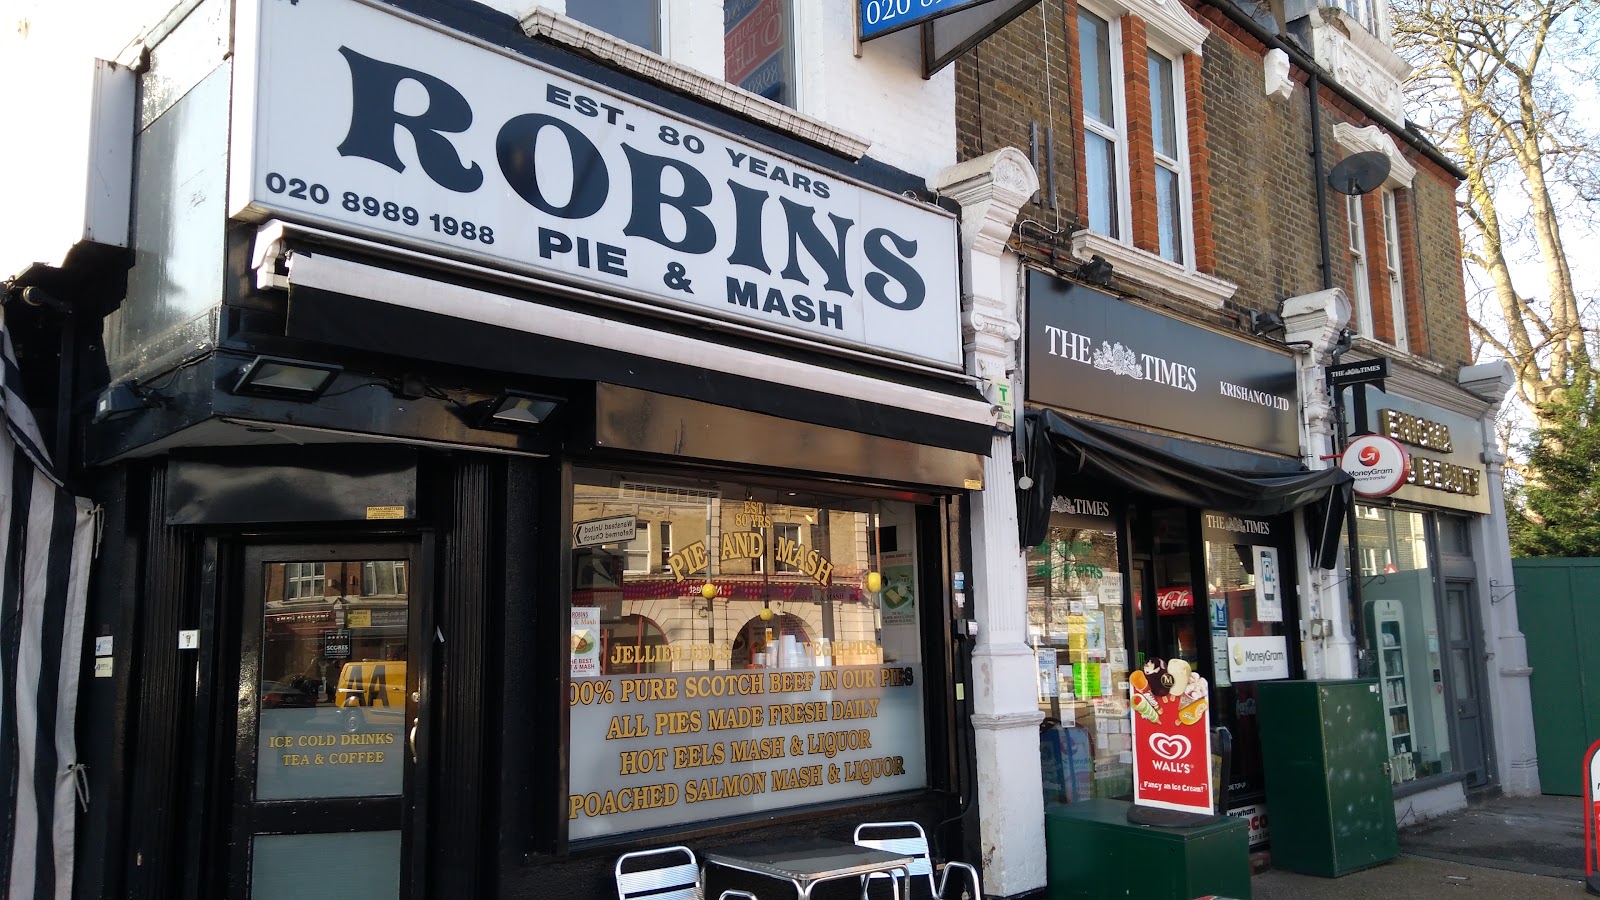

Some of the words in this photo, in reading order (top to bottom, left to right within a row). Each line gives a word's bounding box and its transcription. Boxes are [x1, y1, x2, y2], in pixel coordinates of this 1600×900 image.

[867, 0, 910, 24] 020
[546, 83, 635, 131] EST.
[658, 125, 705, 154] 80
[724, 146, 830, 199] YEARS
[336, 45, 926, 311] ROBINS
[265, 172, 329, 205] 020
[342, 192, 419, 226] 8989
[429, 213, 495, 245] 1988
[538, 226, 628, 278] PIE
[663, 262, 694, 295] &
[725, 276, 843, 330] MASH
[1045, 325, 1091, 365] THE
[1141, 353, 1197, 392] TIMES
[1360, 364, 1380, 373] TIMES
[1219, 381, 1272, 407] KRISHANCO
[1273, 394, 1290, 411] LTD
[1348, 468, 1393, 477] MoneyGram
[1074, 499, 1109, 517] TIMES
[735, 513, 748, 527] 80
[1205, 514, 1226, 530] THE
[1244, 519, 1270, 535] TIMES
[668, 540, 709, 583] PIE
[720, 531, 764, 562] AND
[775, 536, 834, 587] MASH
[611, 645, 684, 664] JELLIED
[690, 643, 731, 661] EELS
[849, 640, 878, 656] PIES
[1245, 650, 1284, 664] MoneyGram
[570, 679, 614, 706] 00%
[620, 677, 678, 703] PURE
[685, 672, 764, 698] SCOTCH
[769, 671, 816, 695] BEEF
[820, 669, 838, 690] IN
[842, 668, 876, 689] OUR
[880, 666, 914, 688] PIES
[606, 714, 649, 740] ALL
[655, 711, 702, 736] PIES
[708, 706, 764, 731] MADE
[768, 701, 828, 725] FRESH
[832, 698, 880, 721] DAILY
[269, 736, 293, 748] ICE
[298, 734, 336, 747] COLD
[340, 732, 394, 746] DRINKS
[283, 753, 310, 766] TEA
[313, 753, 326, 765] &
[328, 751, 385, 765] COFFEE
[620, 749, 669, 775] HOT
[673, 743, 725, 769] EELS
[731, 737, 785, 763] MASH
[790, 735, 804, 756] &
[808, 728, 872, 758] LIQUOR
[1152, 760, 1190, 774] WALL'S
[569, 783, 679, 819] POACHED
[685, 772, 766, 803] SALMON
[772, 766, 823, 792] MASH
[827, 763, 841, 784] &
[844, 755, 906, 785] LIQUOR
[1144, 781, 1162, 791] Fancy
